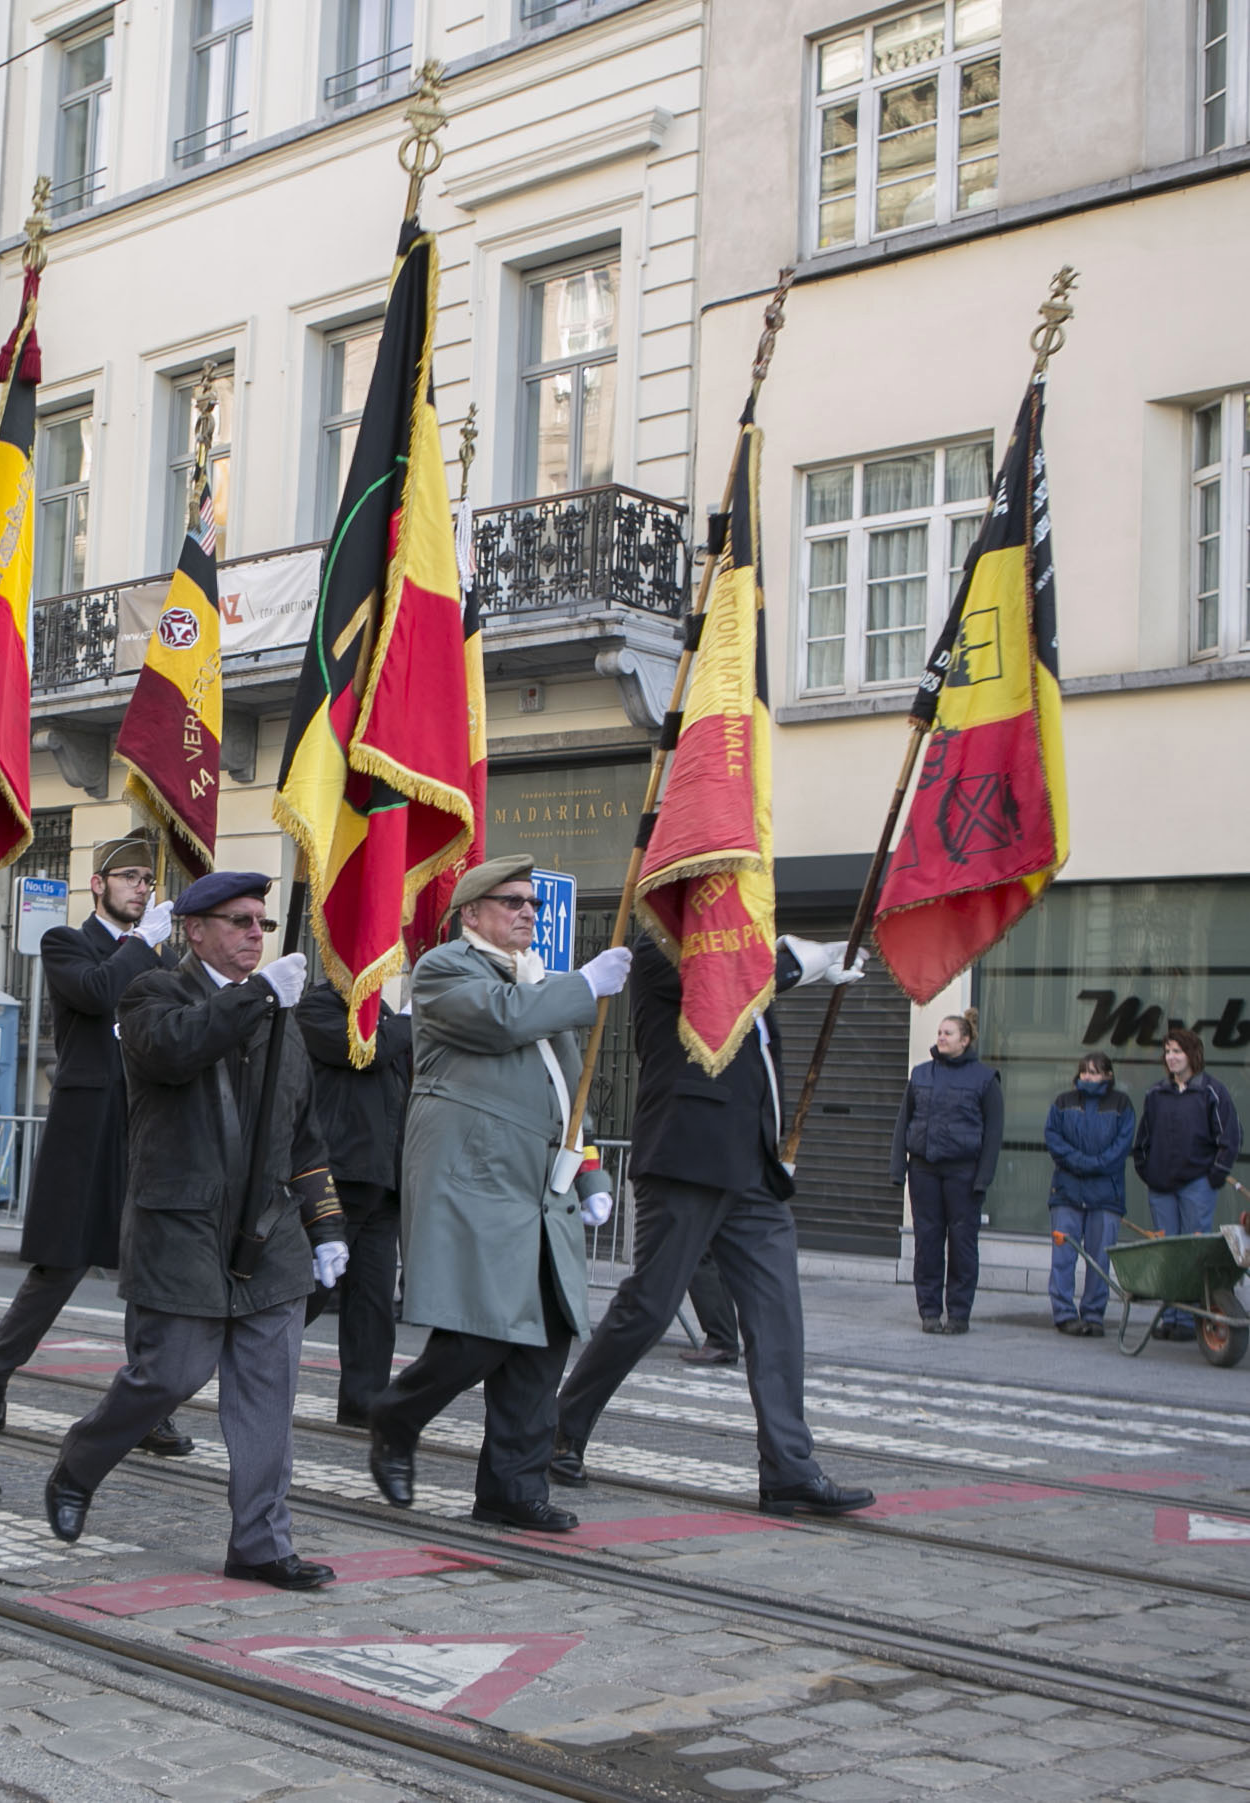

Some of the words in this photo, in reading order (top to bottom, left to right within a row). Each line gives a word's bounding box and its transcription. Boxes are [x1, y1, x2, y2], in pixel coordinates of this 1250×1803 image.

[718, 656, 745, 778] NATIONALE
[190, 767, 216, 800] 44
[494, 801, 629, 824] MADARIAGA
[542, 881, 553, 968] TAXI
